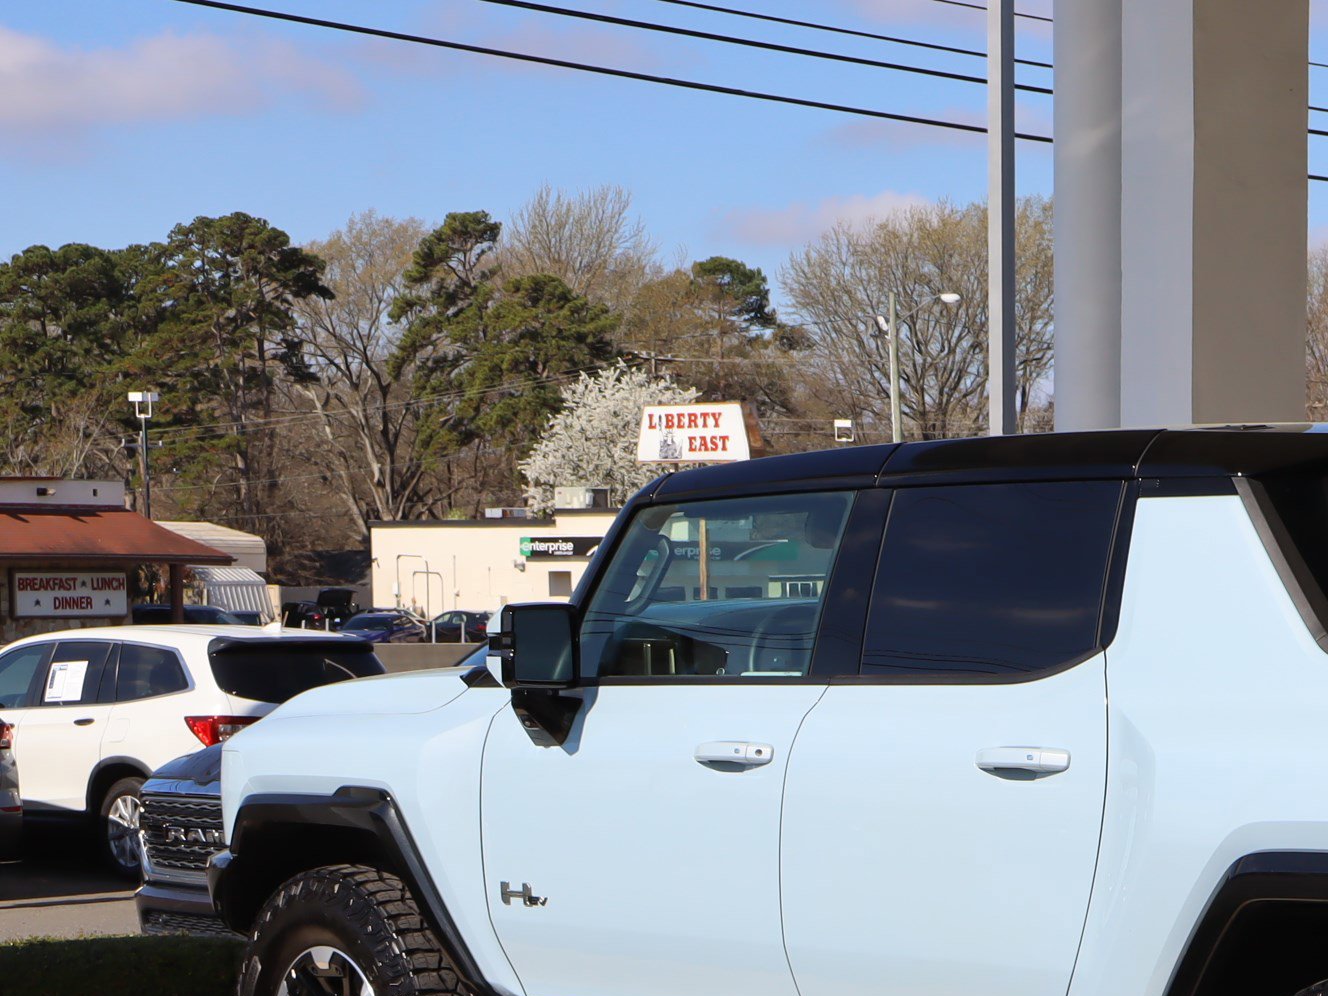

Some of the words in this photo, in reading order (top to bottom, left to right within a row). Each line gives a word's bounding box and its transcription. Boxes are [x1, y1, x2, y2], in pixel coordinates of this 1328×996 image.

[648, 412, 722, 429] LIBERTY
[688, 436, 729, 452] EAST
[522, 540, 574, 554] enterprise
[18, 577, 78, 591] BREAKFAST
[91, 577, 125, 591] LUNCH
[53, 597, 93, 610] DINNER
[165, 825, 226, 842] RAM
